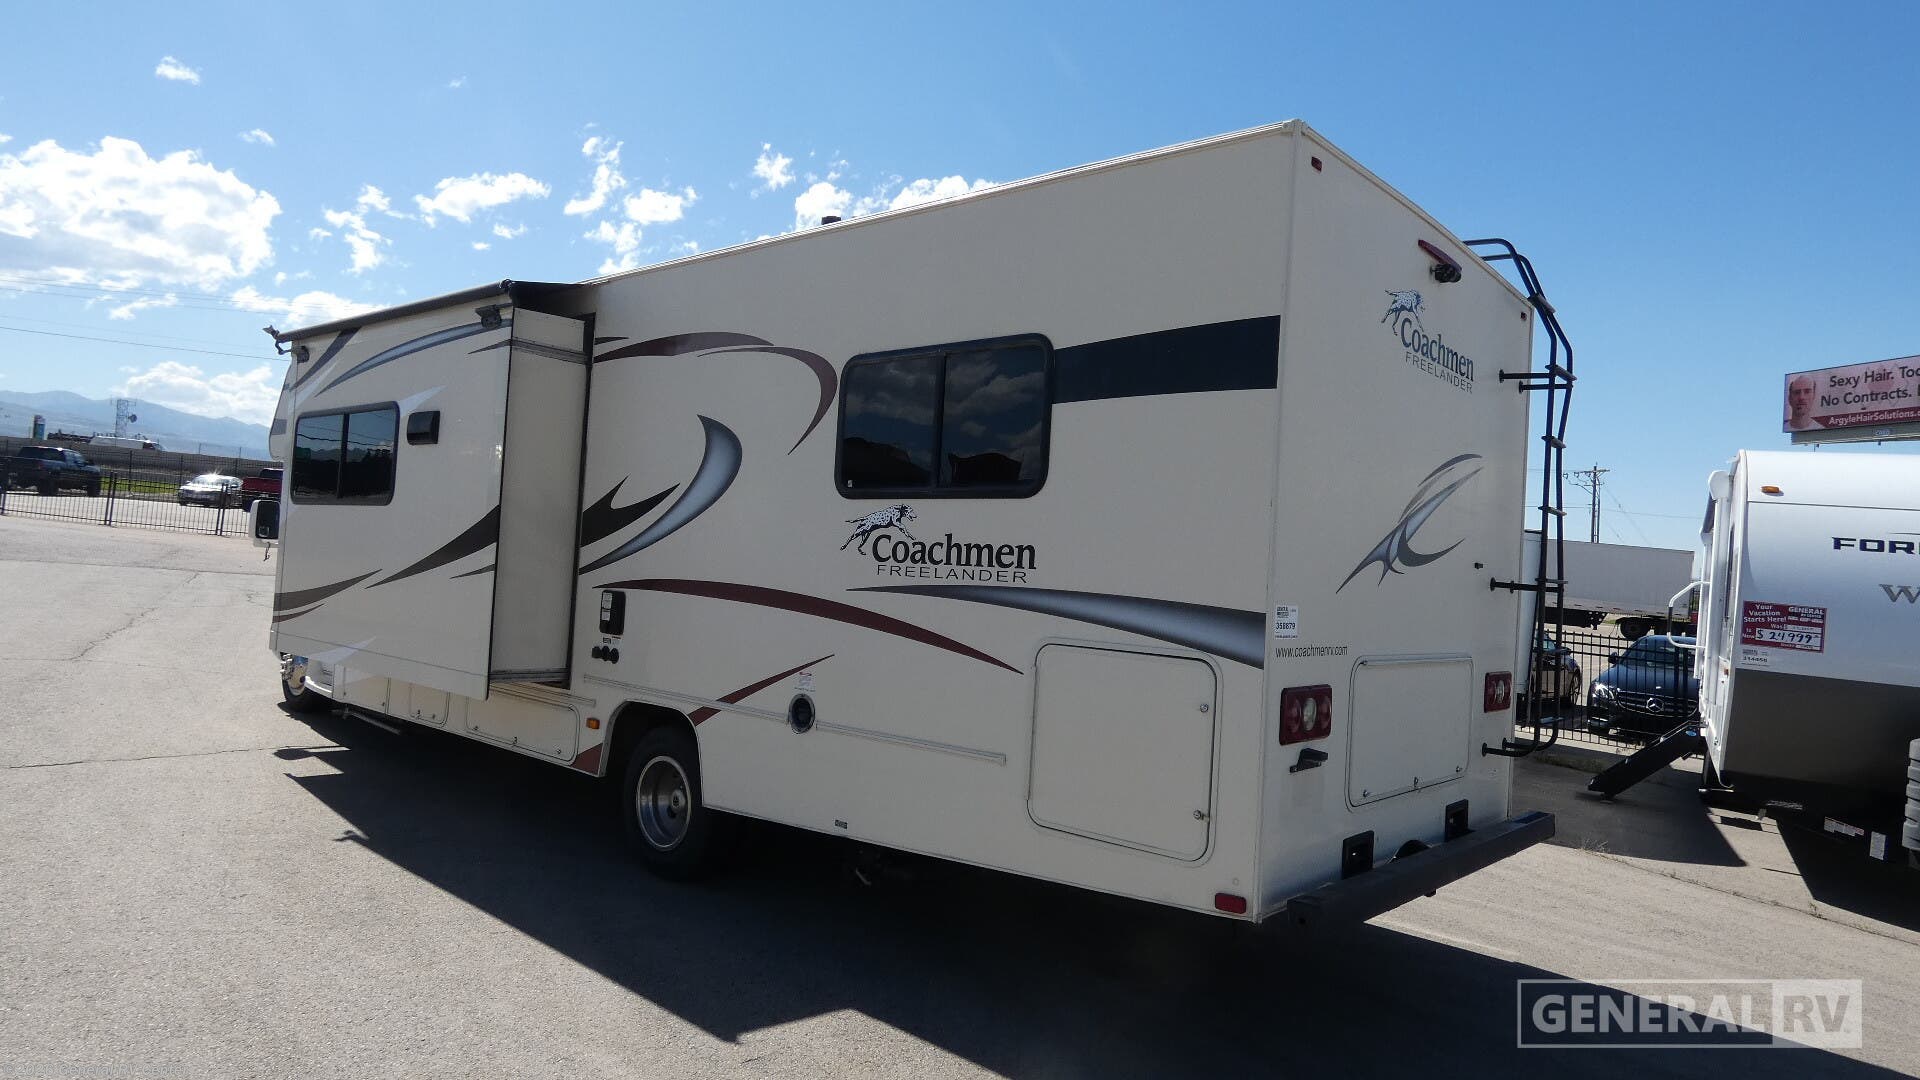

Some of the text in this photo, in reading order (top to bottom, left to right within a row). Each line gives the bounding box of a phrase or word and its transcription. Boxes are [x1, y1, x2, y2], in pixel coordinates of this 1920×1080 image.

[1401, 318, 1474, 382] Coachmen
[1405, 351, 1473, 394] FREELANDER
[1829, 374, 1860, 389] Sexy
[1864, 369, 1894, 383] Hair.
[1820, 395, 1839, 407] No
[1843, 388, 1912, 405] Contracts.
[872, 533, 1037, 570] Coachmen
[1832, 536, 1920, 555] FOR
[877, 564, 1028, 584] FREELANDER
[1788, 606, 1824, 615] GENERAL
[1275, 644, 1348, 658] www.coachmenrv.com
